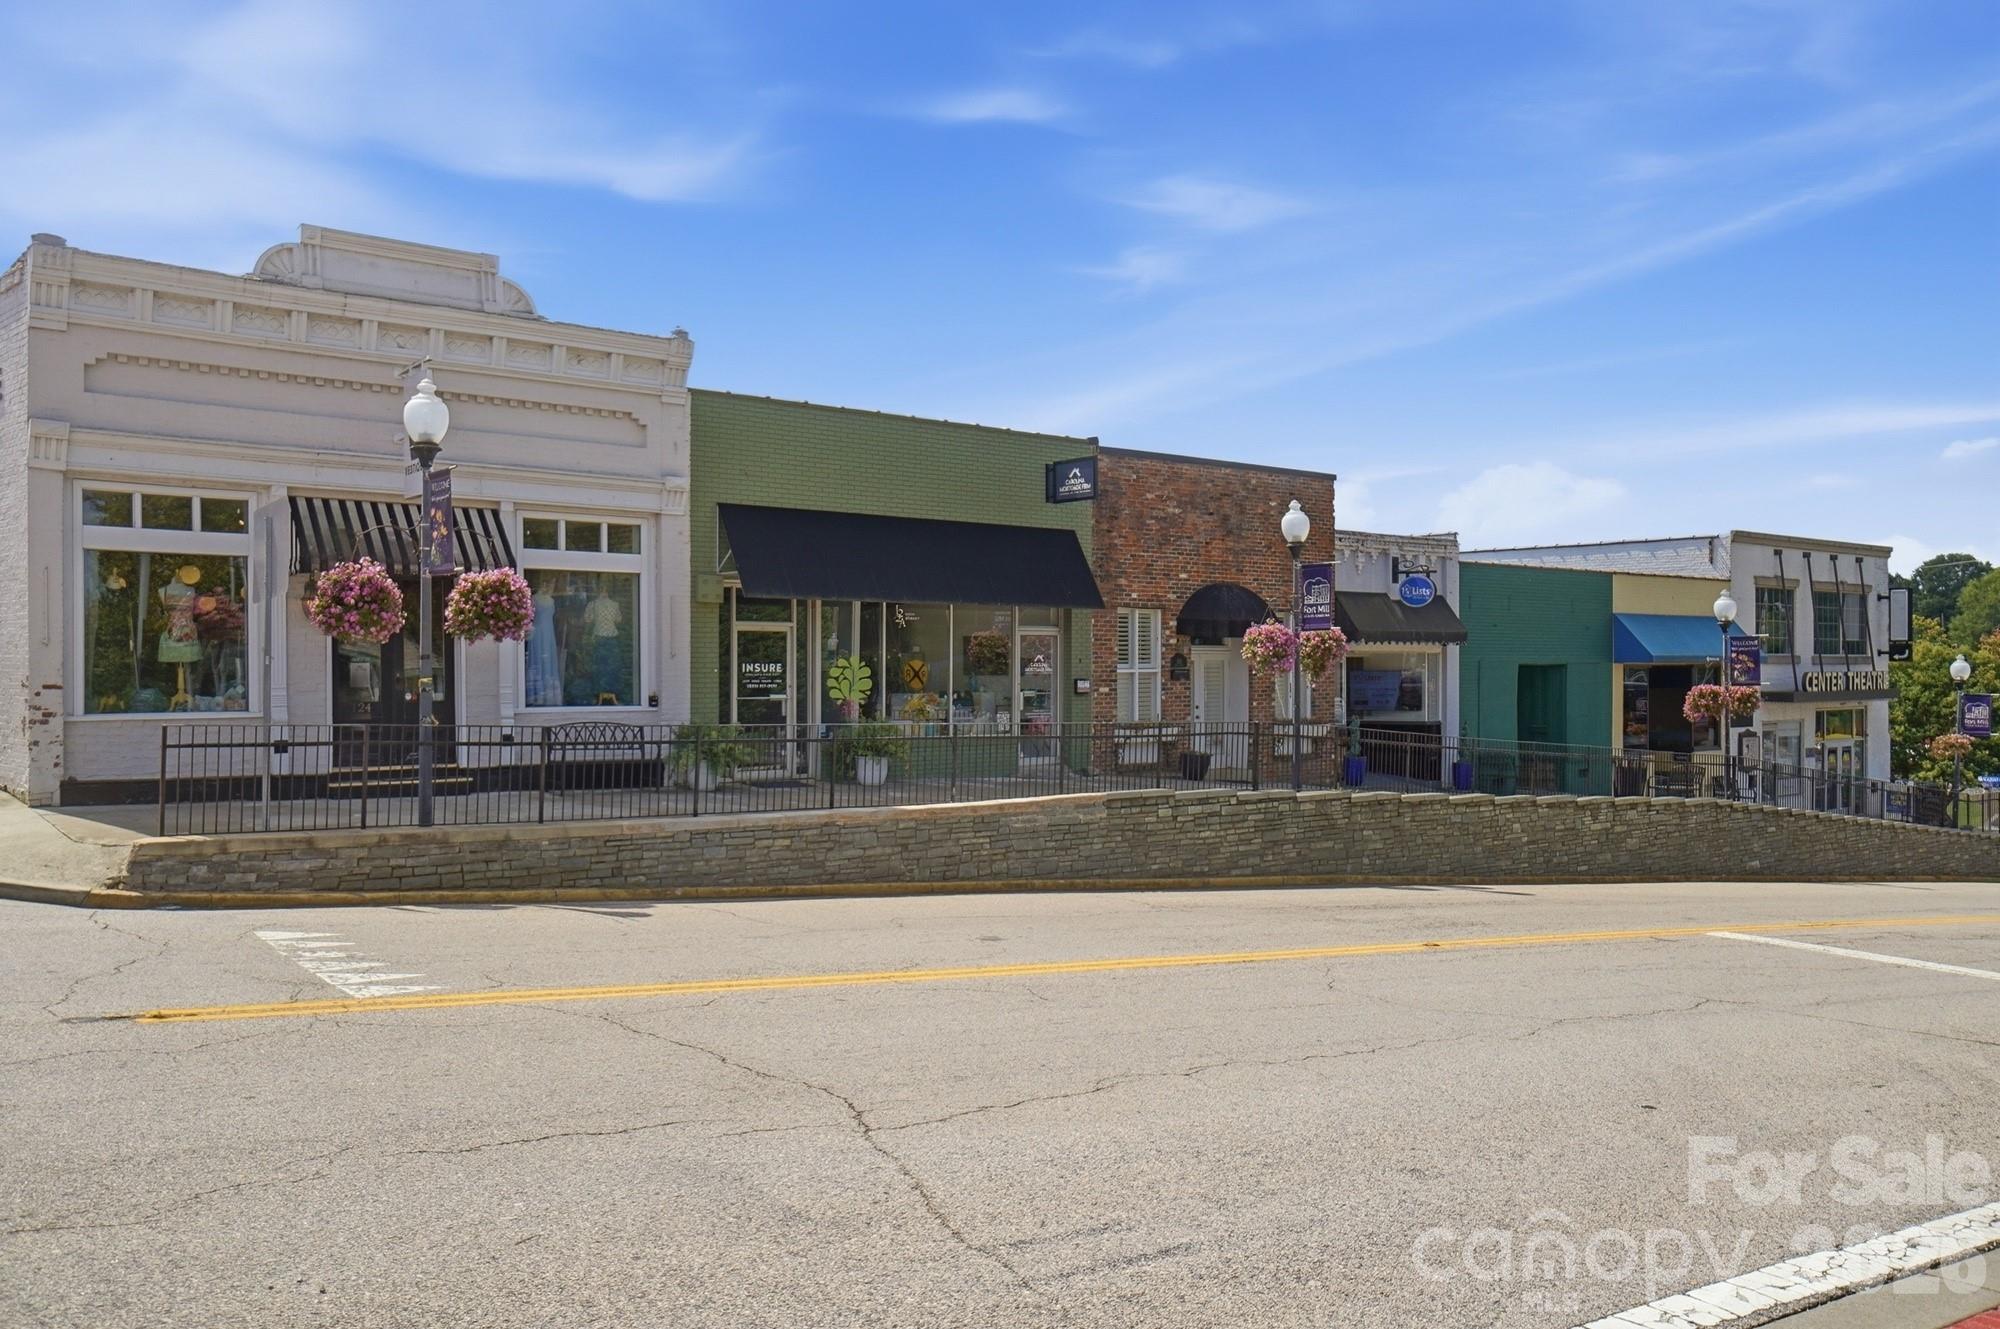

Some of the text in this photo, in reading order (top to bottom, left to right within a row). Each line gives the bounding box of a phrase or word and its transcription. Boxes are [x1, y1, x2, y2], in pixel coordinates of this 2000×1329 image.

[1412, 586, 1431, 596] Lists
[1303, 604, 1330, 614] Fort Mill
[742, 663, 783, 673] INSURE
[1805, 671, 1845, 692] CENTER
